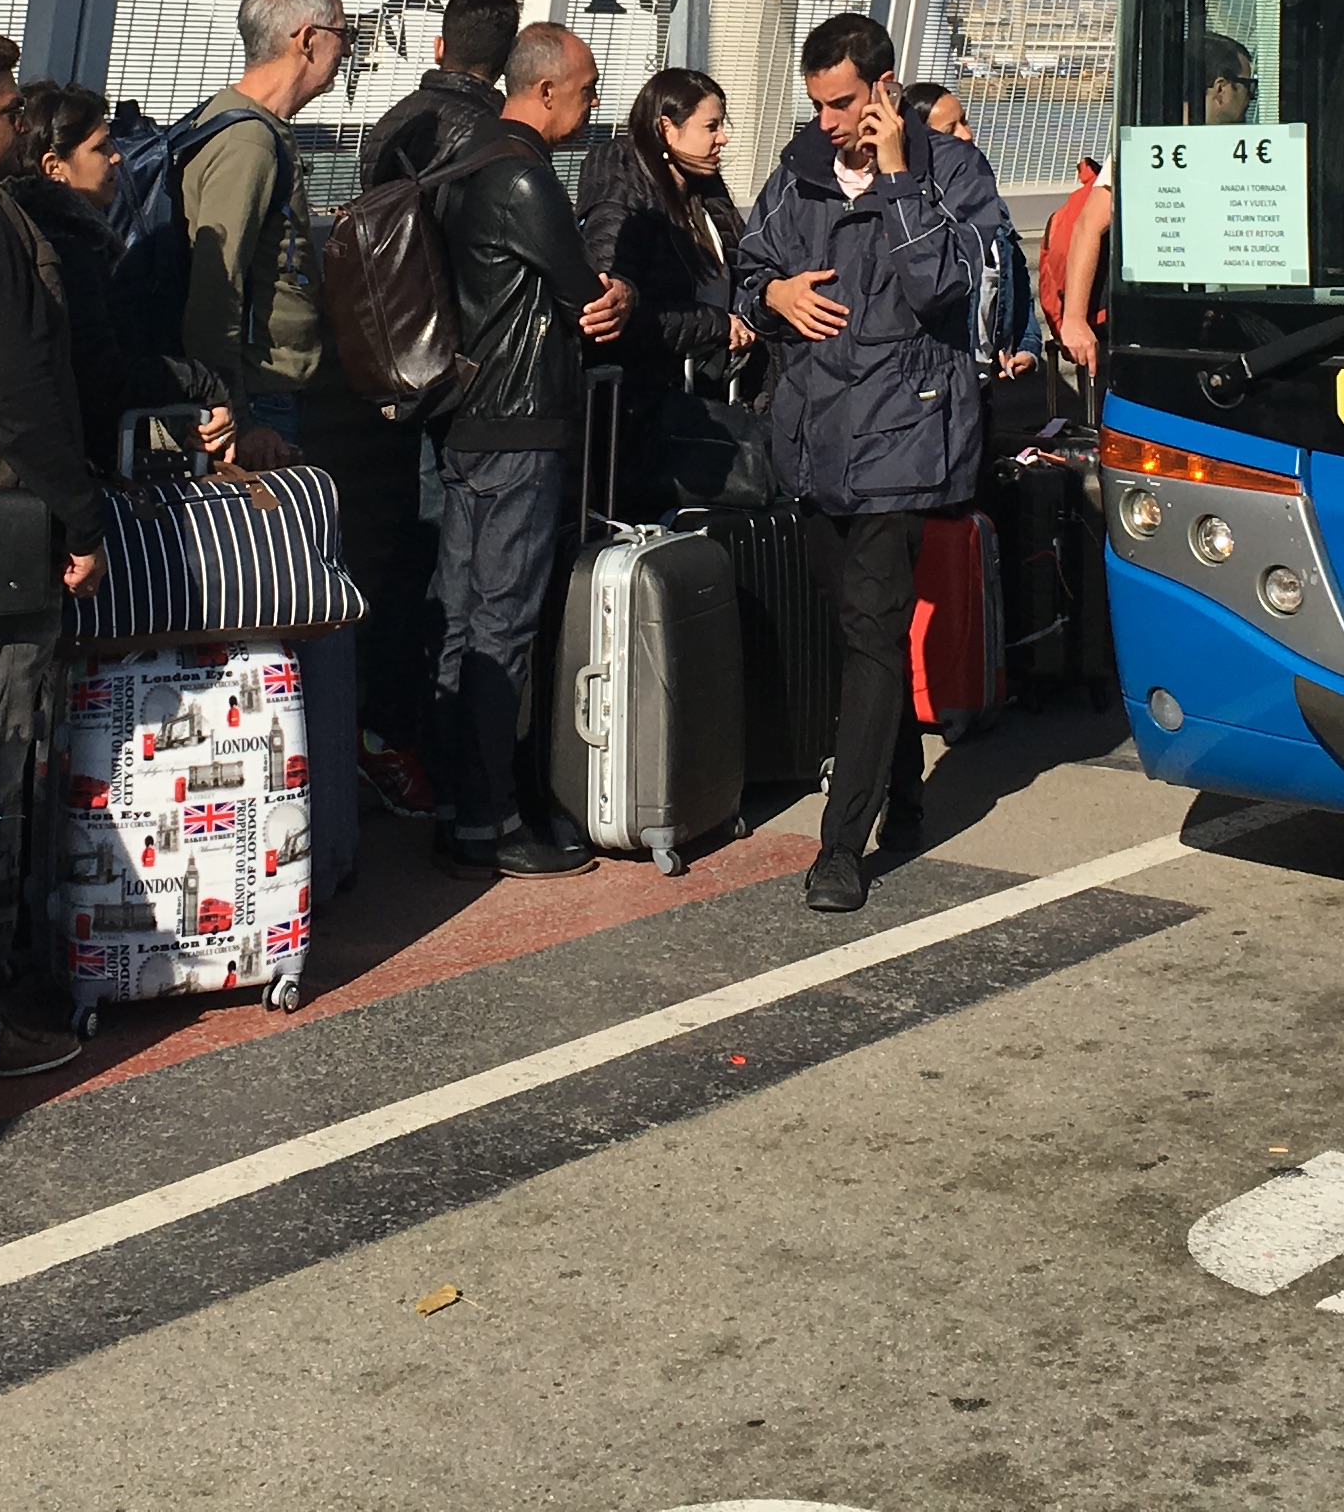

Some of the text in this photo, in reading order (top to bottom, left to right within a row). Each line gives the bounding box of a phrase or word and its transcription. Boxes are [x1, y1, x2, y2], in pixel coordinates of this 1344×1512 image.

[1150, 144, 1187, 169] 3 €
[1233, 138, 1272, 164] 4 €
[1220, 184, 1245, 192] ANADA
[1251, 184, 1286, 192] TORNADA
[1227, 214, 1280, 222] RETURN TICKET
[1223, 230, 1244, 238] ALLER
[1157, 260, 1185, 268] ANDATA
[141, 669, 234, 684] London Eye
[112, 676, 124, 737] PROPERTY
[124, 675, 135, 806] CITY OF LONDON
[215, 735, 269, 755] LONDON
[121, 810, 152, 821] Eye
[235, 799, 246, 925] PROPERTY OF LONDON
[247, 797, 257, 926] CITY OF LONDON
[126, 876, 184, 896] LONDON
[137, 935, 235, 954] London Eye
